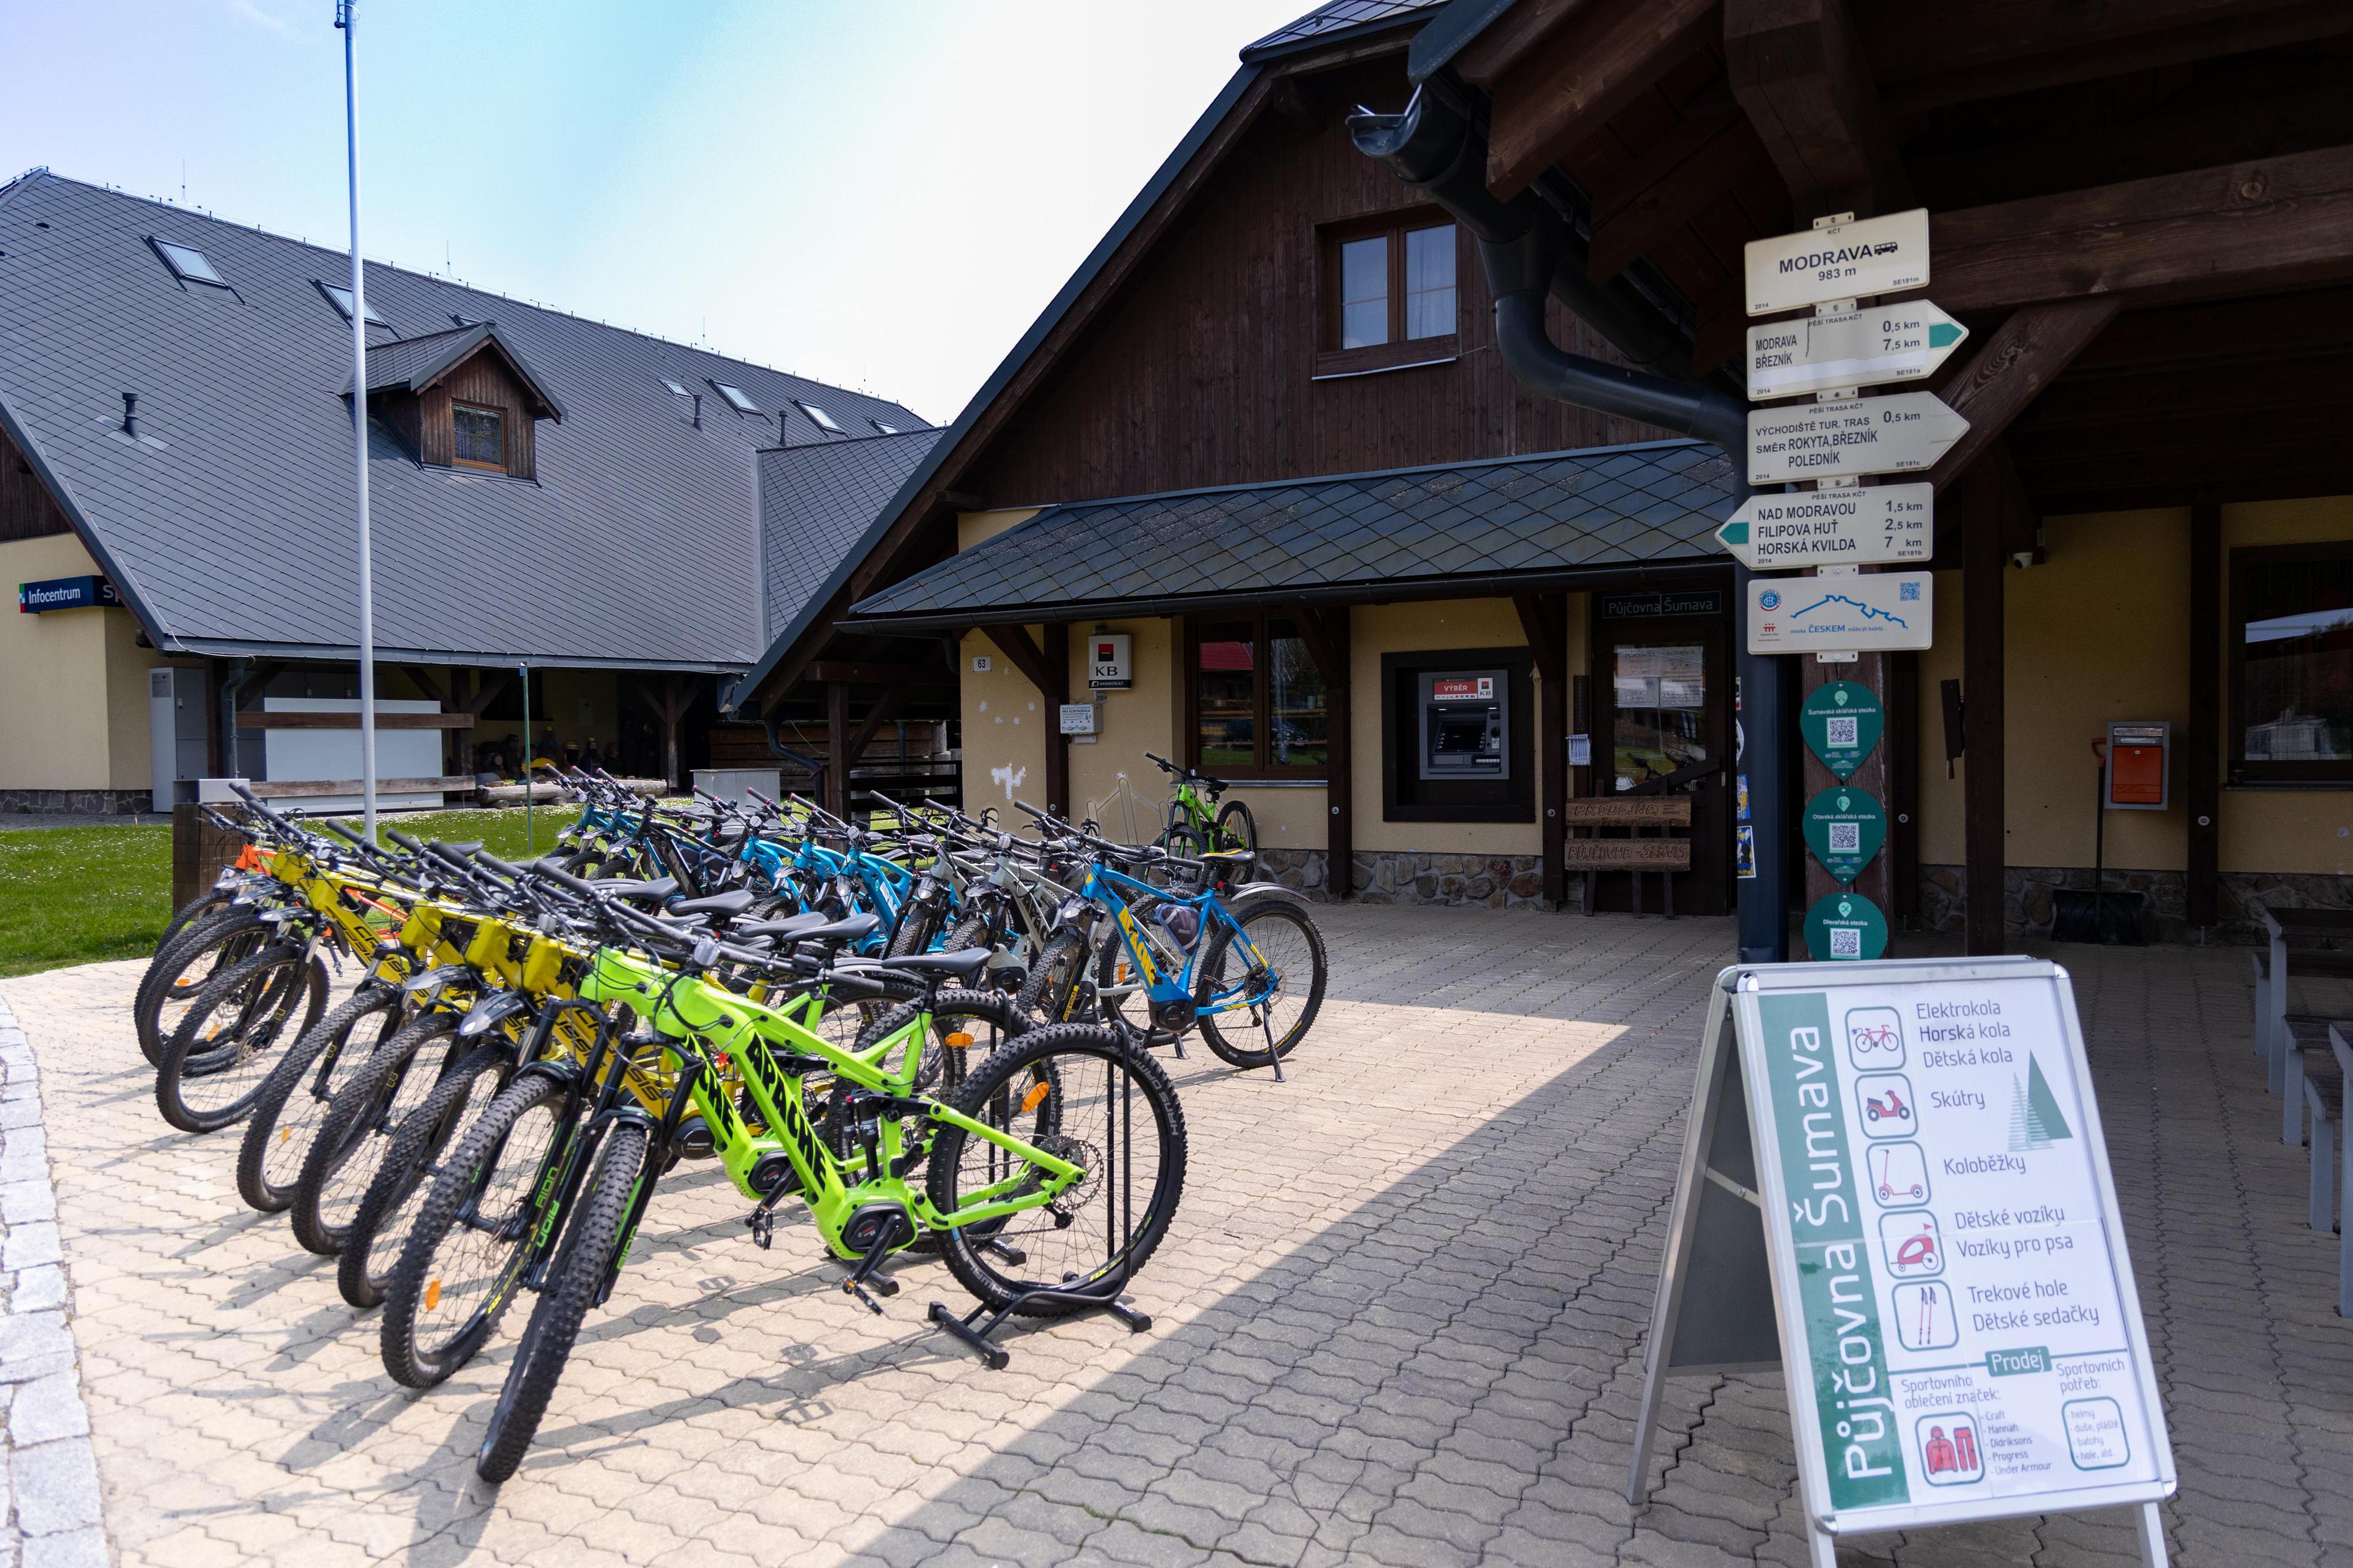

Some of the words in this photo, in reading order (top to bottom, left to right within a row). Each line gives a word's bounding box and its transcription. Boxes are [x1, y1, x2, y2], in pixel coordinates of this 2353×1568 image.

[1779, 244, 1873, 274] MODRAVA
[1818, 269, 1840, 281] 983
[1845, 266, 1857, 277] m
[1892, 277, 1920, 286] SE181m
[1808, 318, 1824, 327] PĚŠÍ
[1825, 316, 1848, 325] TRASA
[1849, 313, 1863, 322] KČT
[1755, 334, 1798, 352] MODRAVA
[1882, 320, 1901, 333] 0,5
[1904, 319, 1920, 329] km
[1755, 353, 1793, 370] BŘEZNÍK
[1882, 338, 1901, 352] 7,5
[1904, 338, 1920, 348] km
[1896, 368, 1921, 376] SE181a
[1809, 406, 1825, 415] PĚŠÍ
[1826, 405, 1849, 413] TRASA
[1849, 402, 1864, 411] KČT
[1755, 420, 1817, 437] VÝCHODIŠTĚ
[1819, 419, 1841, 430] TUR.
[1843, 416, 1870, 428] TRAS
[1884, 411, 1901, 423] 0,5
[1904, 412, 1921, 421] km
[1756, 442, 1786, 453] SMĚR
[1788, 449, 1840, 468] POLEDNÍK
[1758, 508, 1783, 521] NAD
[1787, 503, 1856, 519] MODRAVOU
[1885, 501, 1904, 513] 1,5
[1907, 502, 1923, 512] km
[1758, 522, 1811, 538] FILIPOVA
[1814, 519, 1839, 534] HUŤ
[1885, 518, 1904, 531] 2,5
[1907, 520, 1923, 529] km
[1758, 538, 1808, 555] HORSKÁ
[1812, 538, 1857, 552] KVILDA
[1884, 536, 1893, 548] 7
[1906, 538, 1922, 547] km
[29, 587, 81, 604] Infocentrum
[1609, 602, 1661, 616] Půjčovna
[1664, 596, 1713, 612] Šumava
[1808, 624, 1845, 633] ČESKEM
[978, 659, 986, 668] 63
[1095, 666, 1118, 676] KB
[1574, 804, 1659, 816] PRODEJNA
[1118, 906, 1156, 989] APACHE
[1917, 999, 2001, 1020] Elektrokola
[1919, 1024, 1975, 1043] Horská
[1979, 1020, 2011, 1039] kola
[1924, 1049, 1977, 1069] Dětská
[1981, 1047, 2014, 1065] kola
[1931, 1089, 1986, 1111] Skútry
[745, 1032, 826, 1193] APACHE
[1158, 1091, 1179, 1136] HANS
[1791, 1026, 1850, 1227] Šumava
[1943, 1154, 2027, 1176] Koloběžky
[1955, 1208, 2011, 1230] Dětské
[2015, 1206, 2065, 1227] vozíky
[1957, 1237, 2010, 1260] Vozíky
[2014, 1239, 2041, 1257] pro
[2046, 1236, 2074, 1255] psa
[1967, 1282, 2031, 1305] Trekové
[2034, 1280, 2069, 1297] hole
[1972, 1309, 2028, 1332] Dětské
[2034, 1305, 2099, 1327] sedačky
[1825, 1243, 1894, 1479] Půjčovna
[1991, 1351, 2045, 1373] Prodej
[2057, 1358, 2125, 1378] Sportovních
[1901, 1374, 1973, 1394] Sportovního
[2061, 1377, 2101, 1395] potřeb:
[1905, 1392, 1953, 1409] oblečení
[1955, 1388, 2001, 1404] značek:
[1985, 1410, 2005, 1421] Craft
[2071, 1409, 2095, 1420] helmy
[1988, 1423, 2019, 1434] Hannah
[2075, 1422, 2095, 1433] duše,
[2097, 1419, 2119, 1432] pláště
[1990, 1436, 2033, 1448] Didriksons
[2078, 1436, 2104, 1447] batohy
[1992, 1450, 2029, 1462] Progress
[2081, 1449, 2100, 1460] hole,
[1995, 1464, 2019, 1476] Under
[2021, 1462, 2052, 1473] Armour
